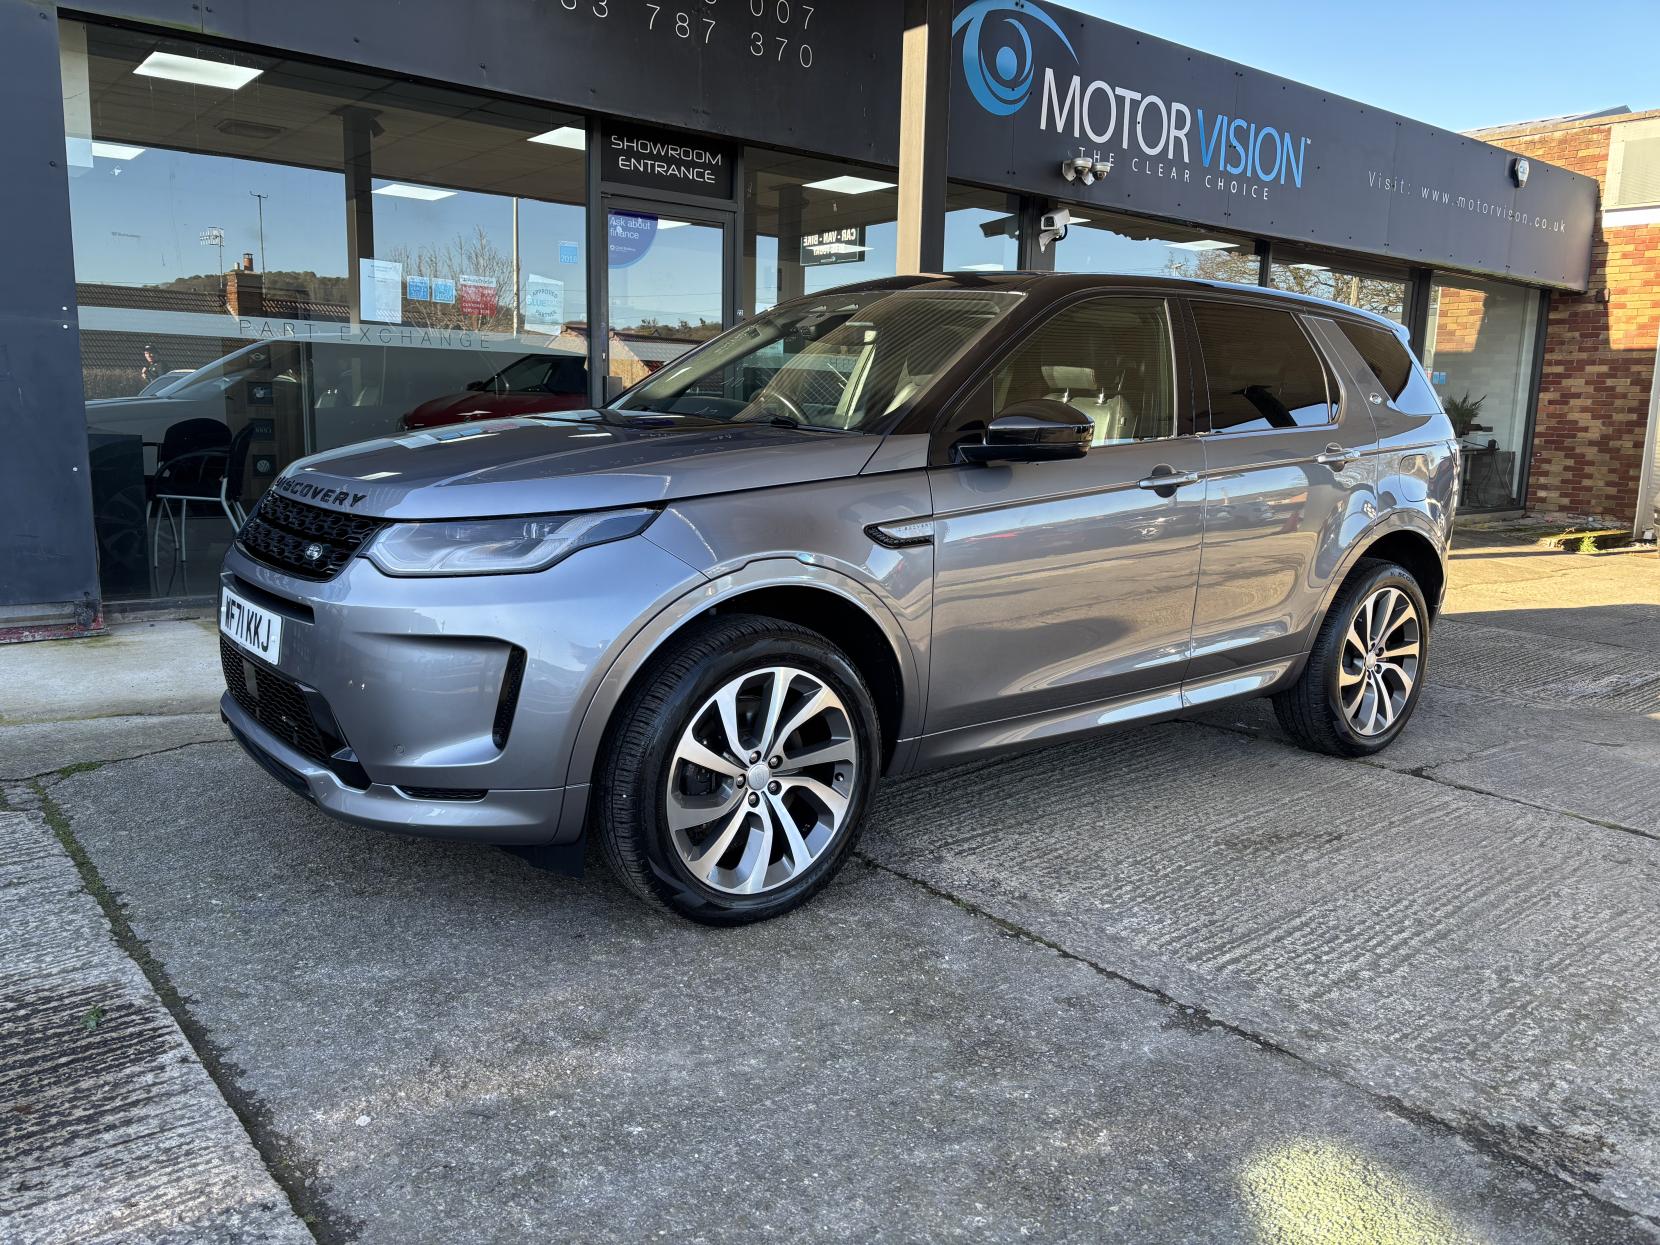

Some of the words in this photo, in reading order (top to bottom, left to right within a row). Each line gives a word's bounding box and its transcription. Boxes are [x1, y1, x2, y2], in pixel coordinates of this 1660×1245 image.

[750, 0, 814, 30] 007
[646, 3, 716, 44] 787
[750, 31, 813, 68] 370
[611, 135, 722, 166] SHOWROOM
[618, 156, 716, 184] ENTRANCE
[1078, 146, 1115, 167] THE
[1131, 158, 1191, 184] CLEAR
[1204, 174, 1270, 201] CHOICE
[1368, 170, 1412, 195] Visit:
[1421, 185, 1567, 233] www.motorvison.co.uk
[610, 216, 626, 227] Ask
[627, 218, 651, 230] about
[610, 227, 640, 239] finance
[238, 319, 317, 340] PART
[339, 325, 491, 350] EXCHANGE
